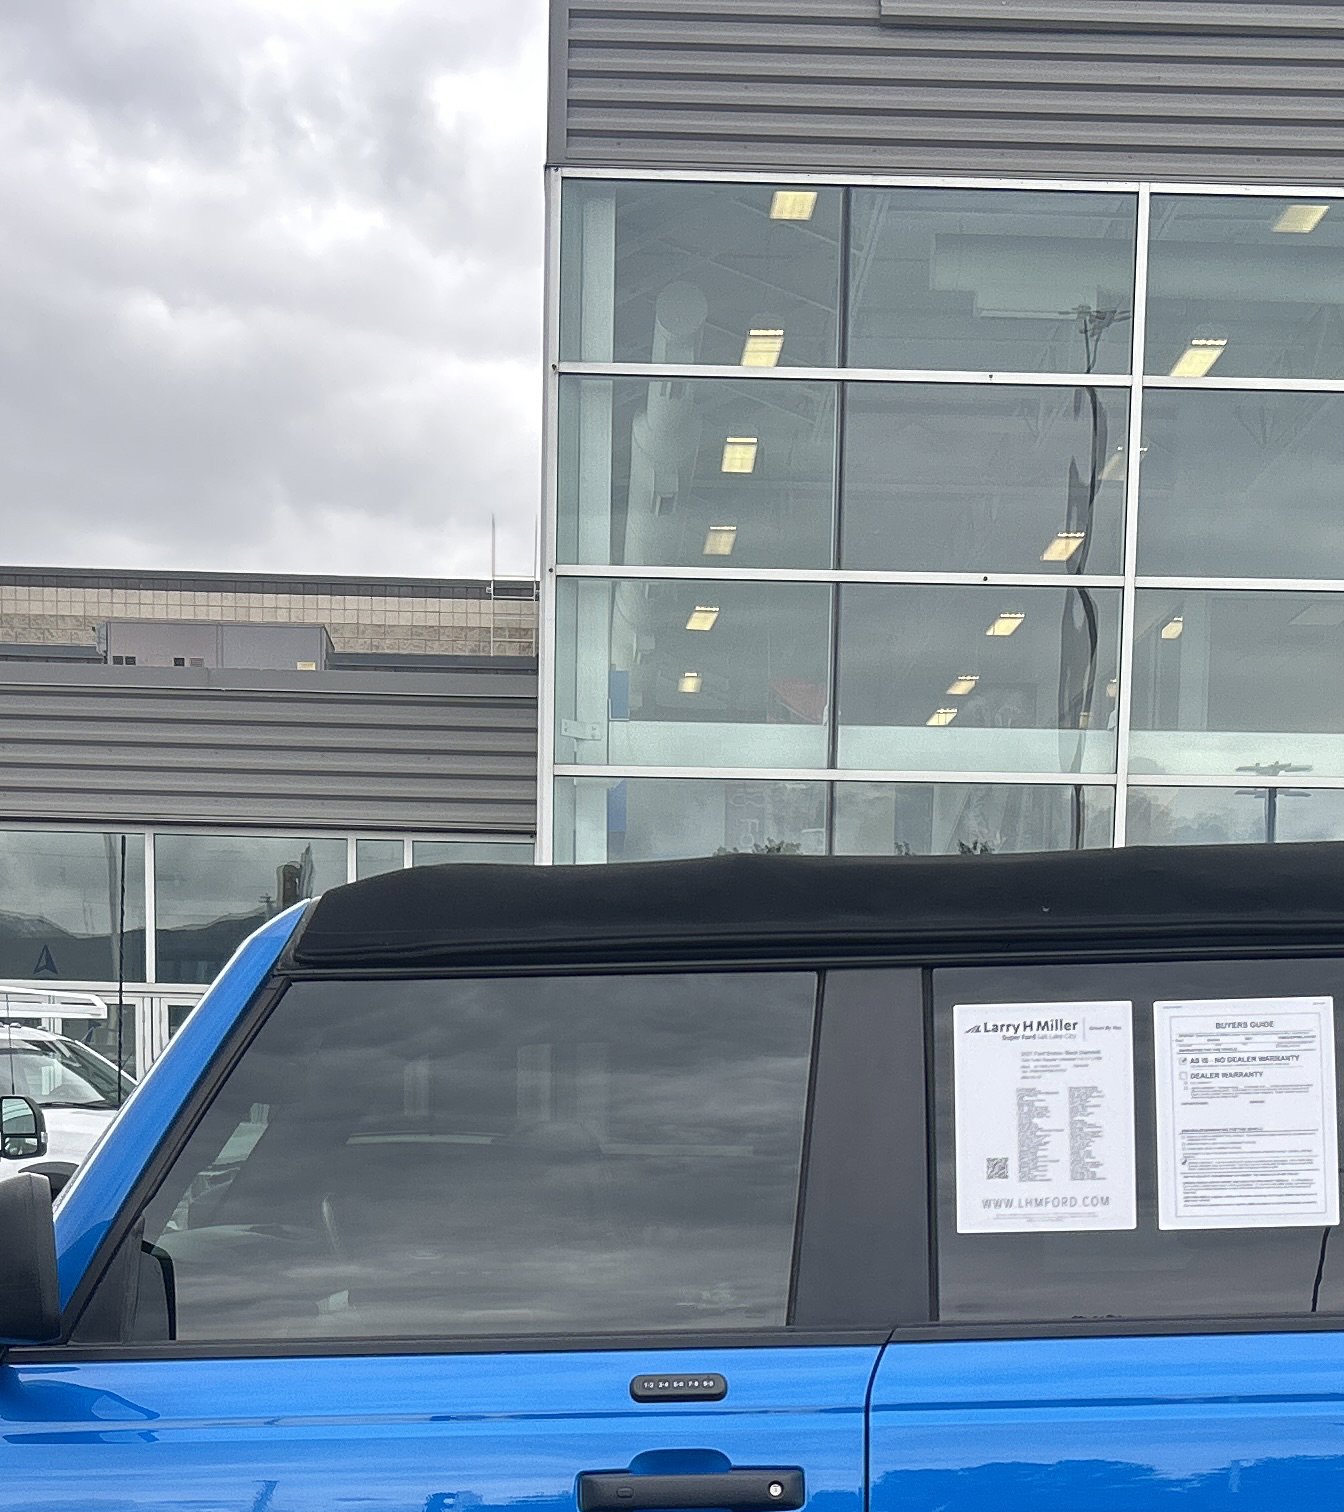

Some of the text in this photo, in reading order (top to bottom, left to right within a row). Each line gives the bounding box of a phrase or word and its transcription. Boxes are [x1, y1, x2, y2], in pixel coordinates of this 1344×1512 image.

[984, 1018, 1079, 1035] Larry H Miller
[1250, 1020, 1275, 1028] GUIDE
[981, 1195, 1110, 1210] WWW.LHMFORD.COM
